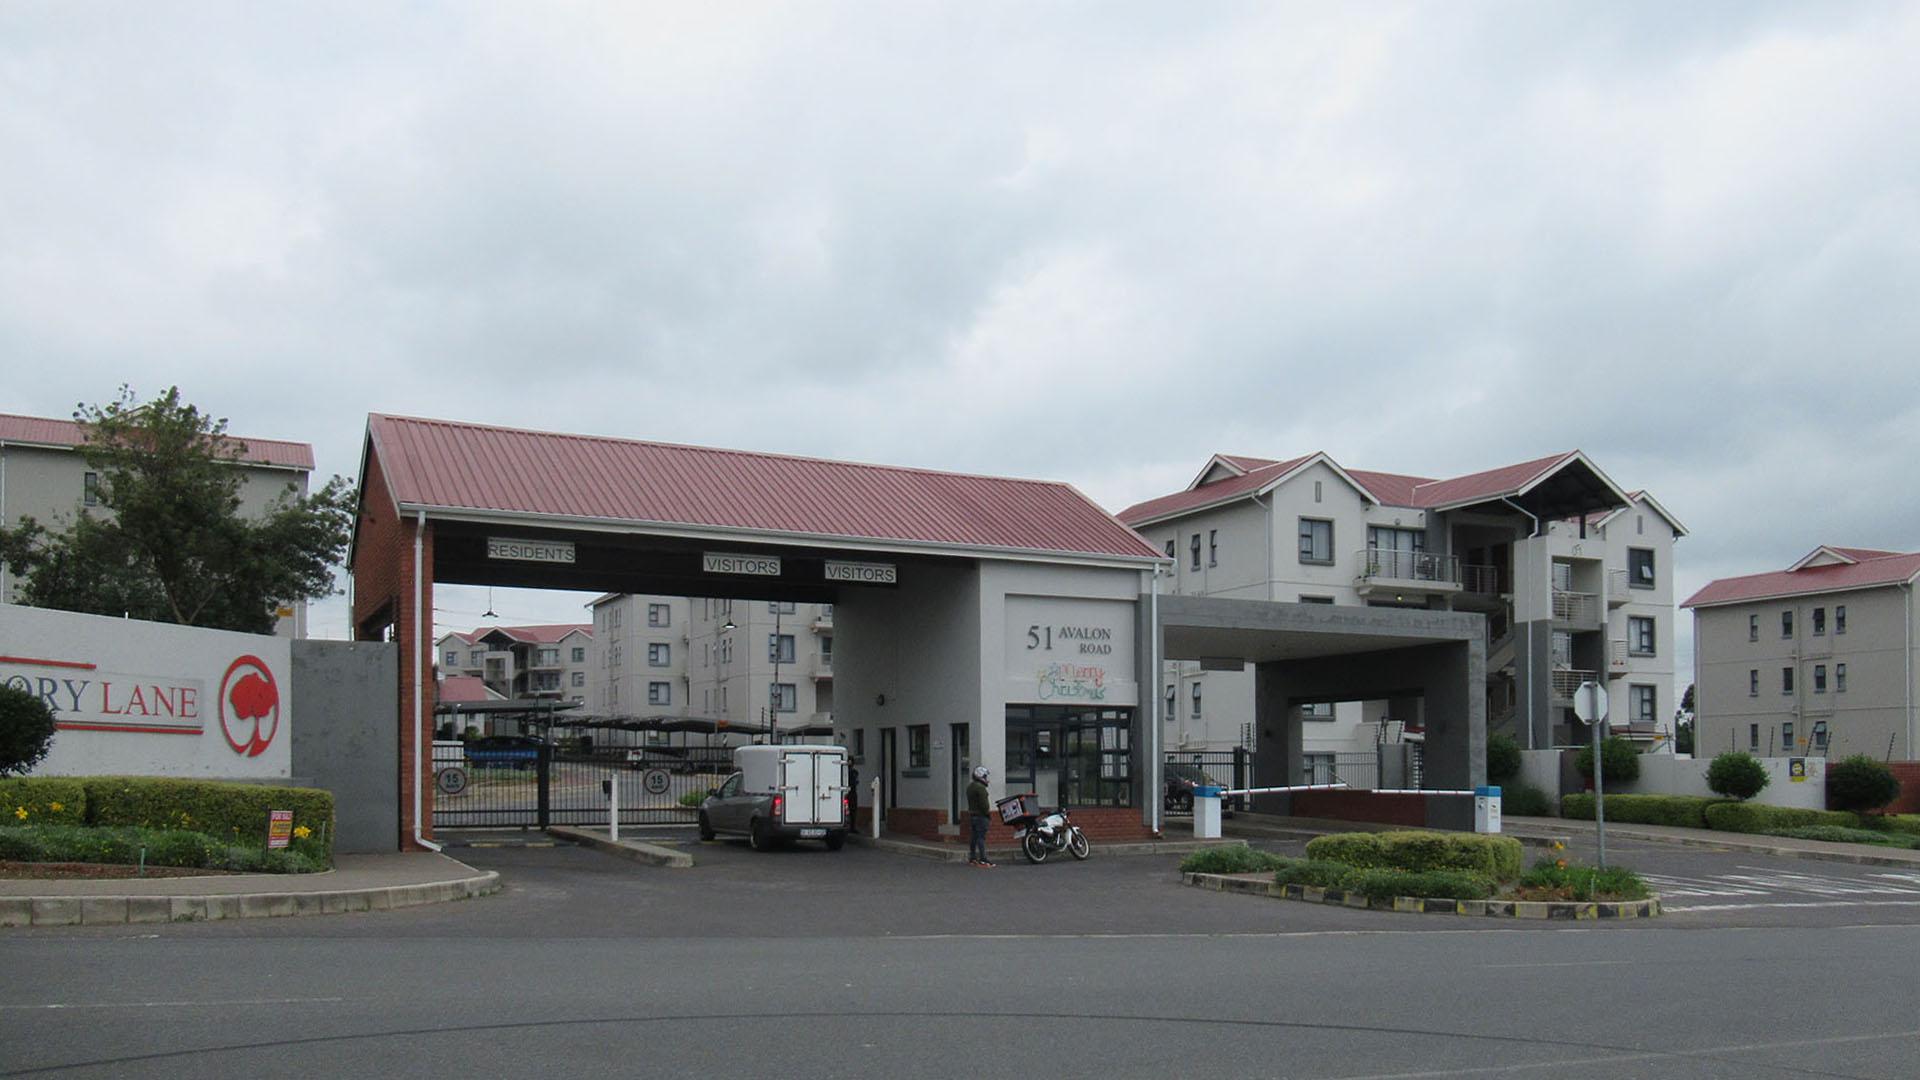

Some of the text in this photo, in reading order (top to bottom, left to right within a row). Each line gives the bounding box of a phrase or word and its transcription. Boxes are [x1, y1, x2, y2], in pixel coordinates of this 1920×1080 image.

[488, 544, 575, 561] RESIDENTS
[707, 558, 778, 574] VISITORS
[827, 566, 894, 582] VISITORS
[1027, 625, 1112, 650] 51 AVALON
[1079, 642, 1112, 655] ROAD
[0, 674, 200, 718] ORY LANE
[446, 773, 459, 784] 15
[650, 775, 663, 784] 15
